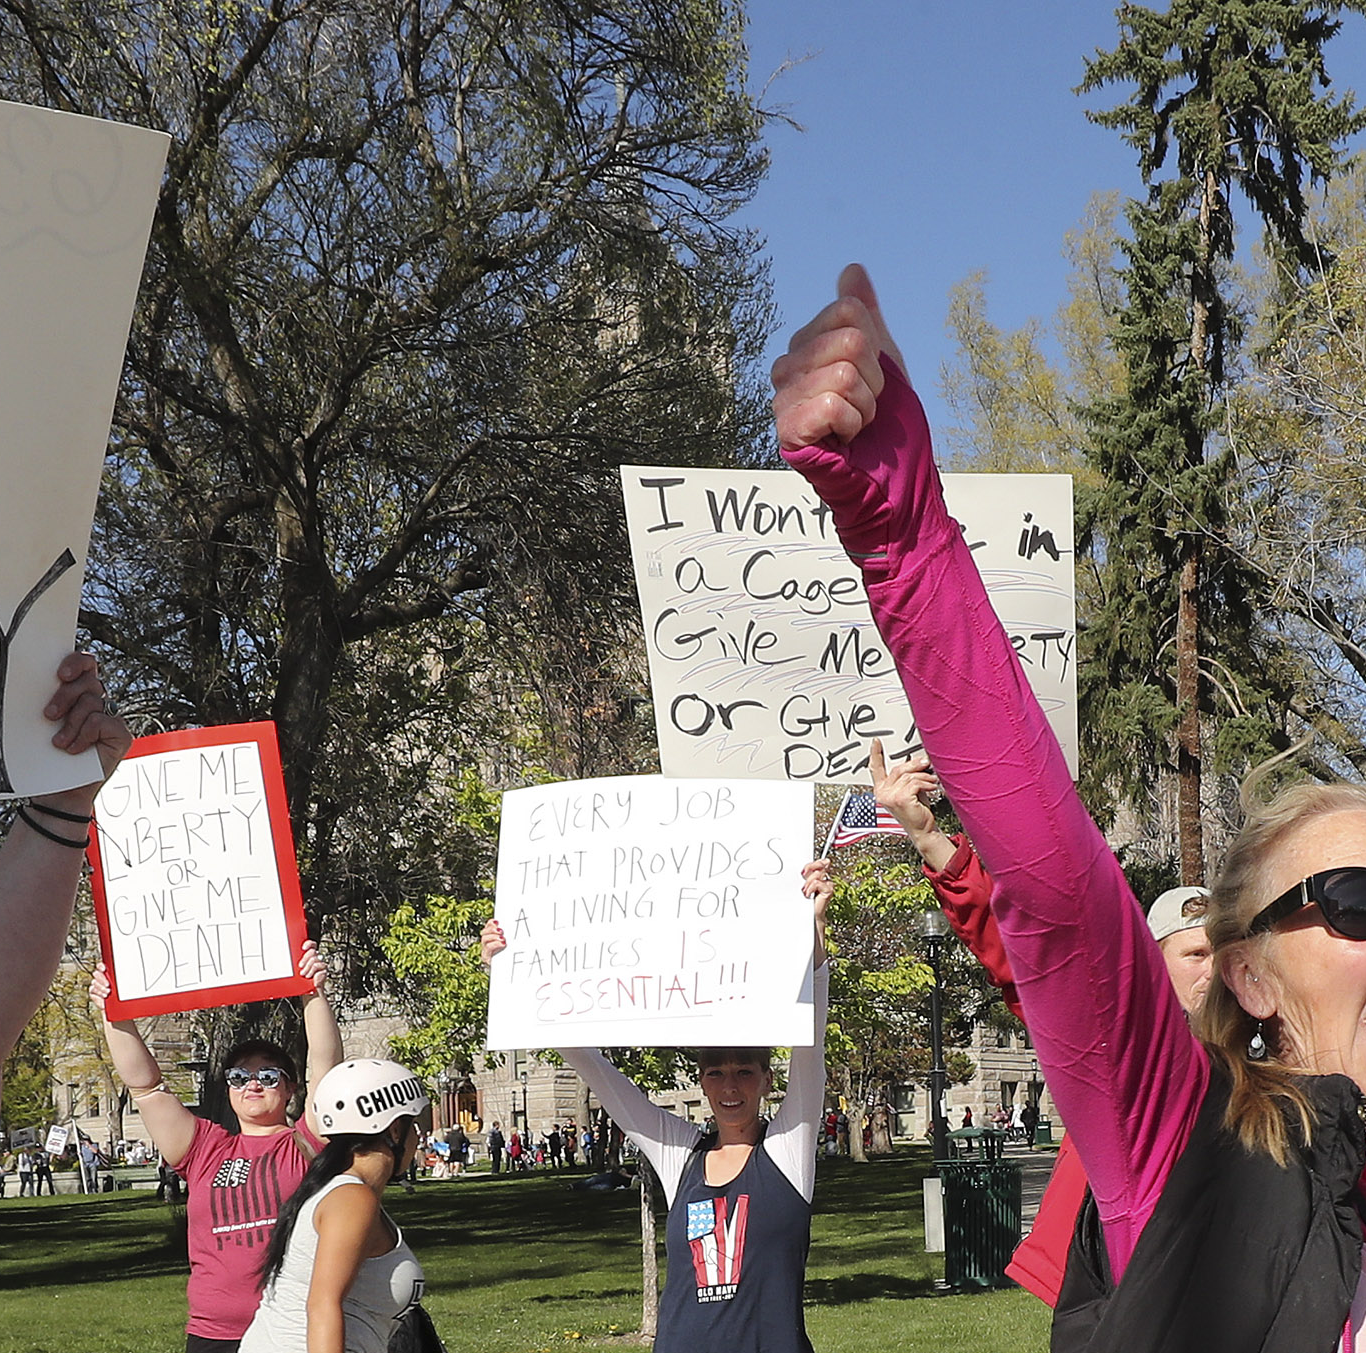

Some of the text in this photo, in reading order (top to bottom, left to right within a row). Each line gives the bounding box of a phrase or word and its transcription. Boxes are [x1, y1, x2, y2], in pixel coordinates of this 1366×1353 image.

[638, 476, 686, 533] I
[1017, 511, 1073, 562] in
[100, 745, 256, 818] GIVE ME
[659, 786, 736, 826] JOB
[166, 858, 206, 886] OR
[518, 837, 785, 895] THAT PROVIDES
[112, 875, 271, 936] GIVE ME
[513, 884, 740, 940] A LIVING FOR
[136, 918, 267, 992] DEATH
[510, 929, 718, 985] FAMILIES IS
